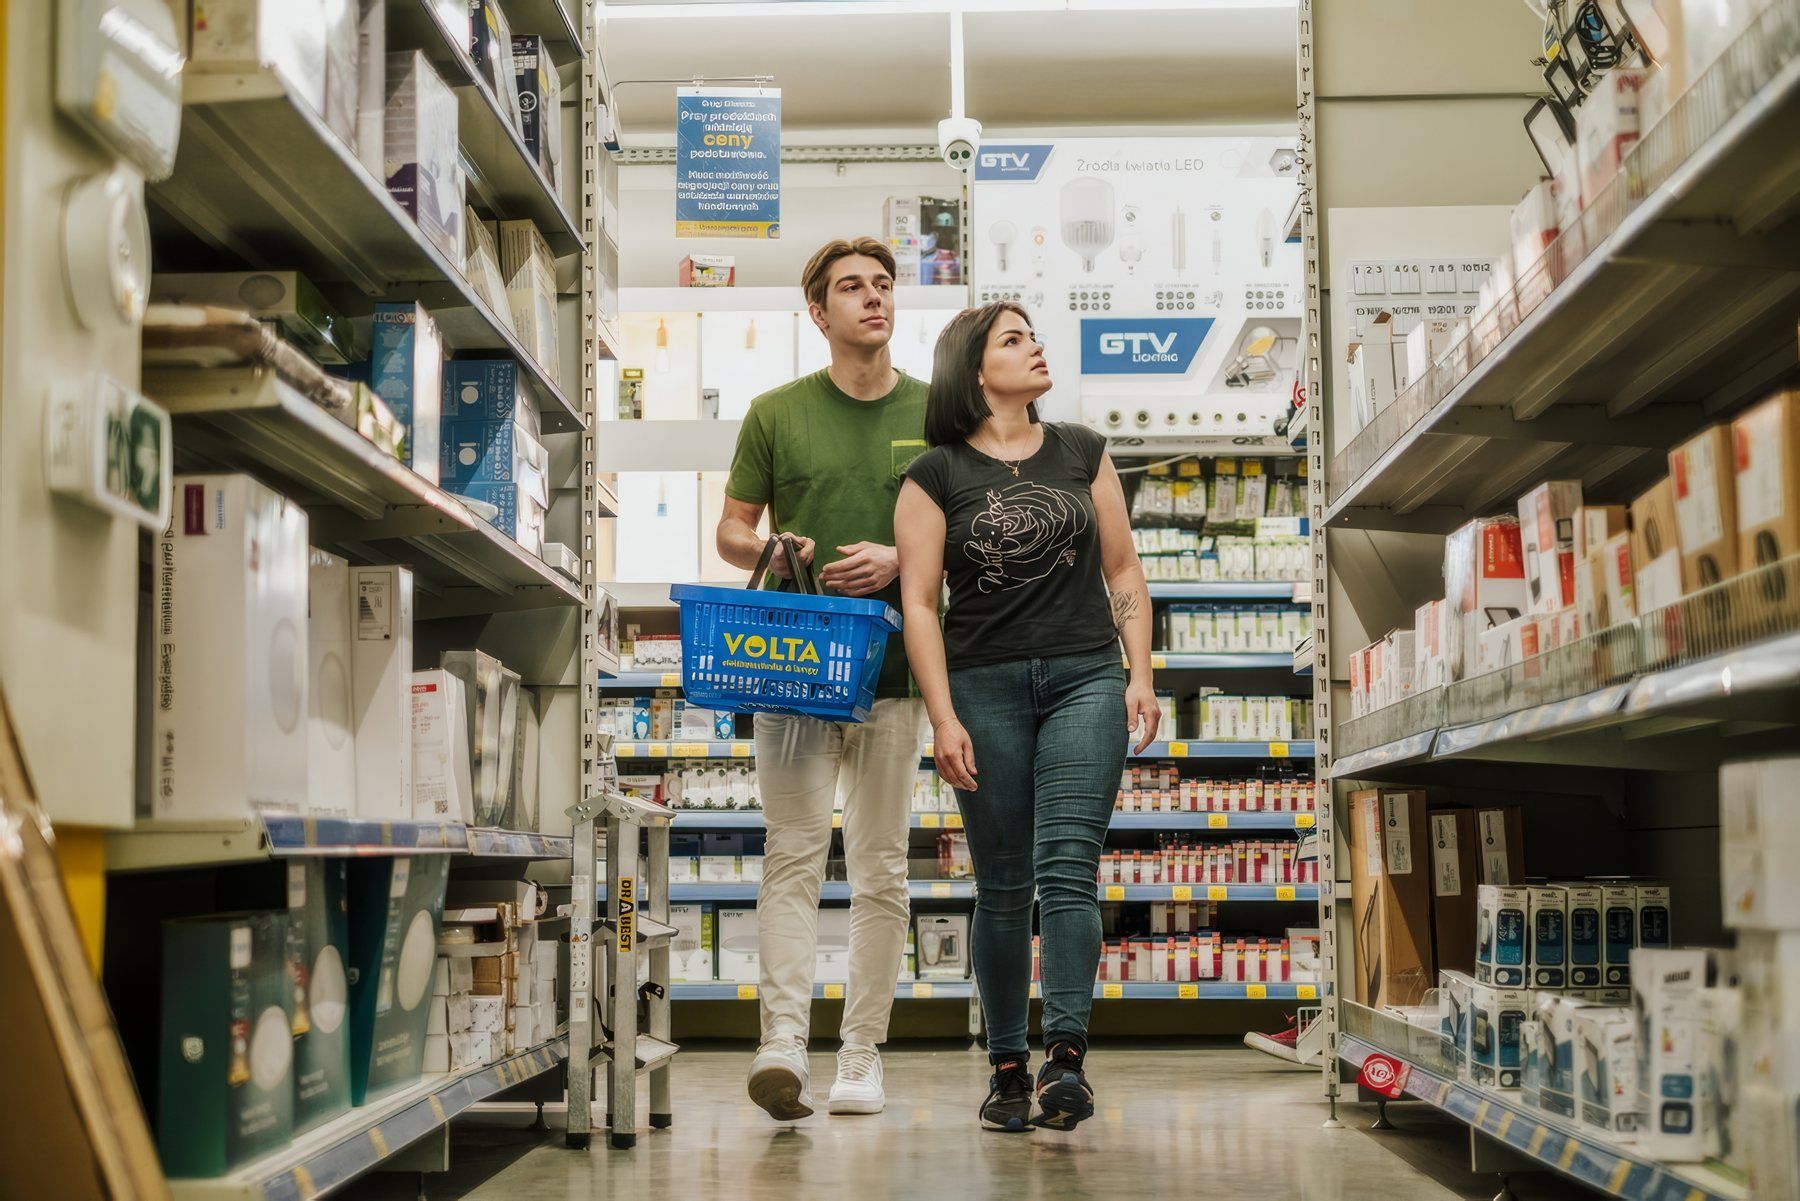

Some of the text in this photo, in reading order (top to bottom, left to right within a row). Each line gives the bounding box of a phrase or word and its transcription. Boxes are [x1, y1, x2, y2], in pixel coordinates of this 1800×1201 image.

[704, 134, 753, 149] ceny
[981, 153, 1029, 167] GTV
[1100, 332, 1178, 355] GTV
[723, 633, 820, 663] VOLTA
[618, 879, 634, 951] DRABEST
